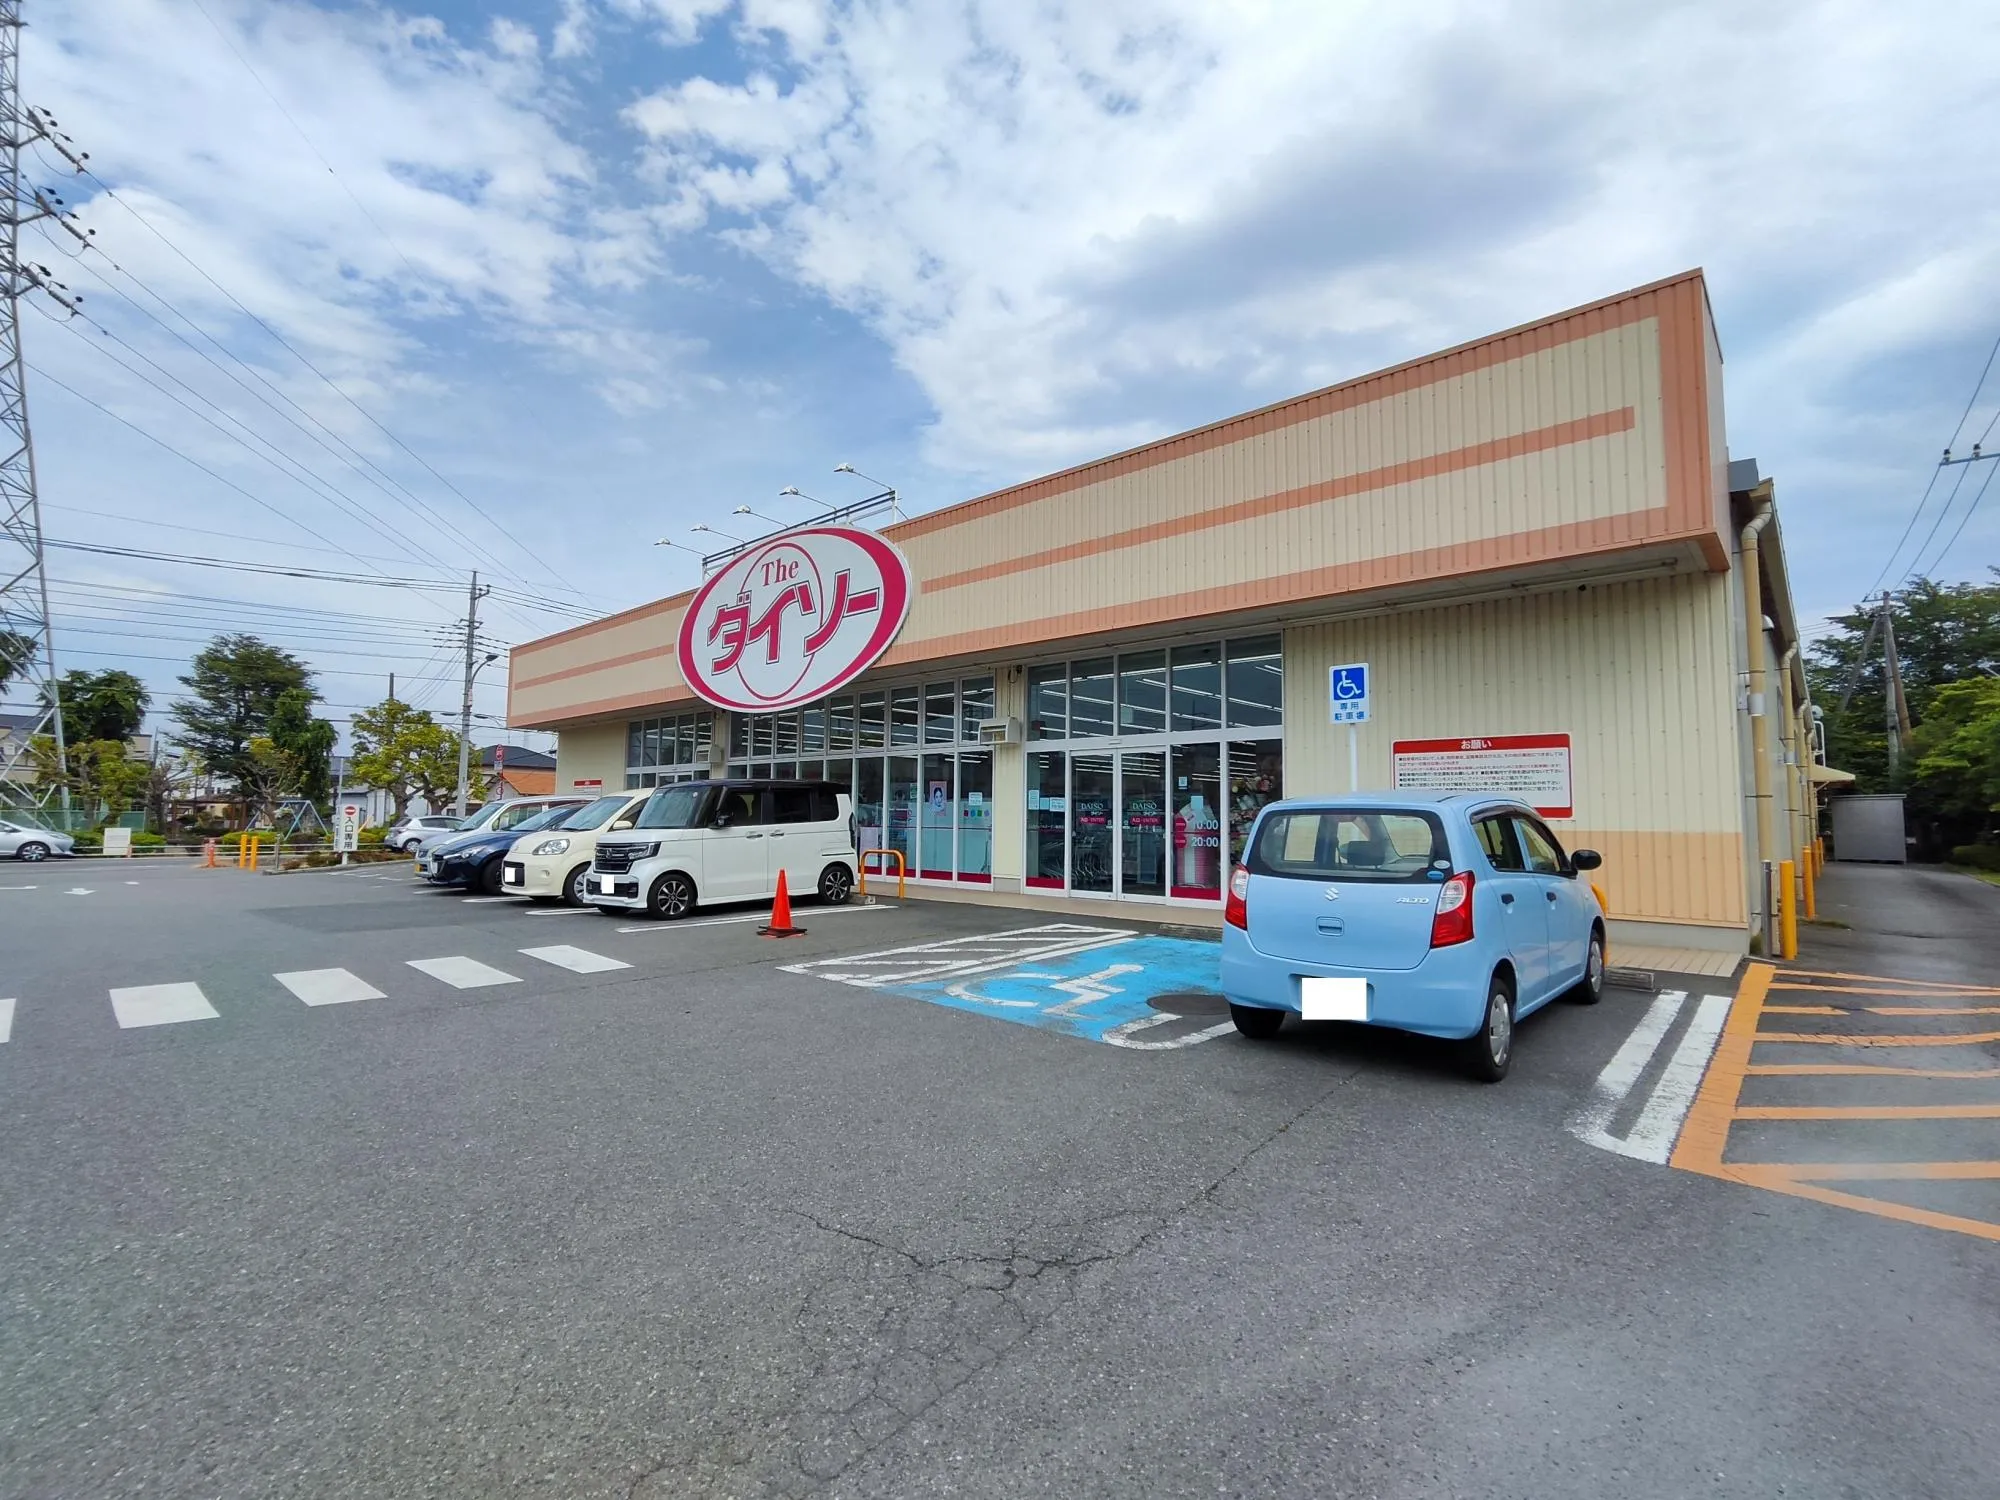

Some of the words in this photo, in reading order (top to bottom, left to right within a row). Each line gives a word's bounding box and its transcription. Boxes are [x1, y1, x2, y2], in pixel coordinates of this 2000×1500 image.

[761, 557, 799, 587] The
[707, 568, 880, 676] ダイソー
[1340, 702, 1359, 711] 専用
[1461, 739, 1492, 750] お願い
[1081, 802, 1104, 810] DAISO
[1132, 801, 1157, 810] DAISO
[344, 817, 353, 849] 入口専用
[1191, 837, 1219, 847] 20:00
